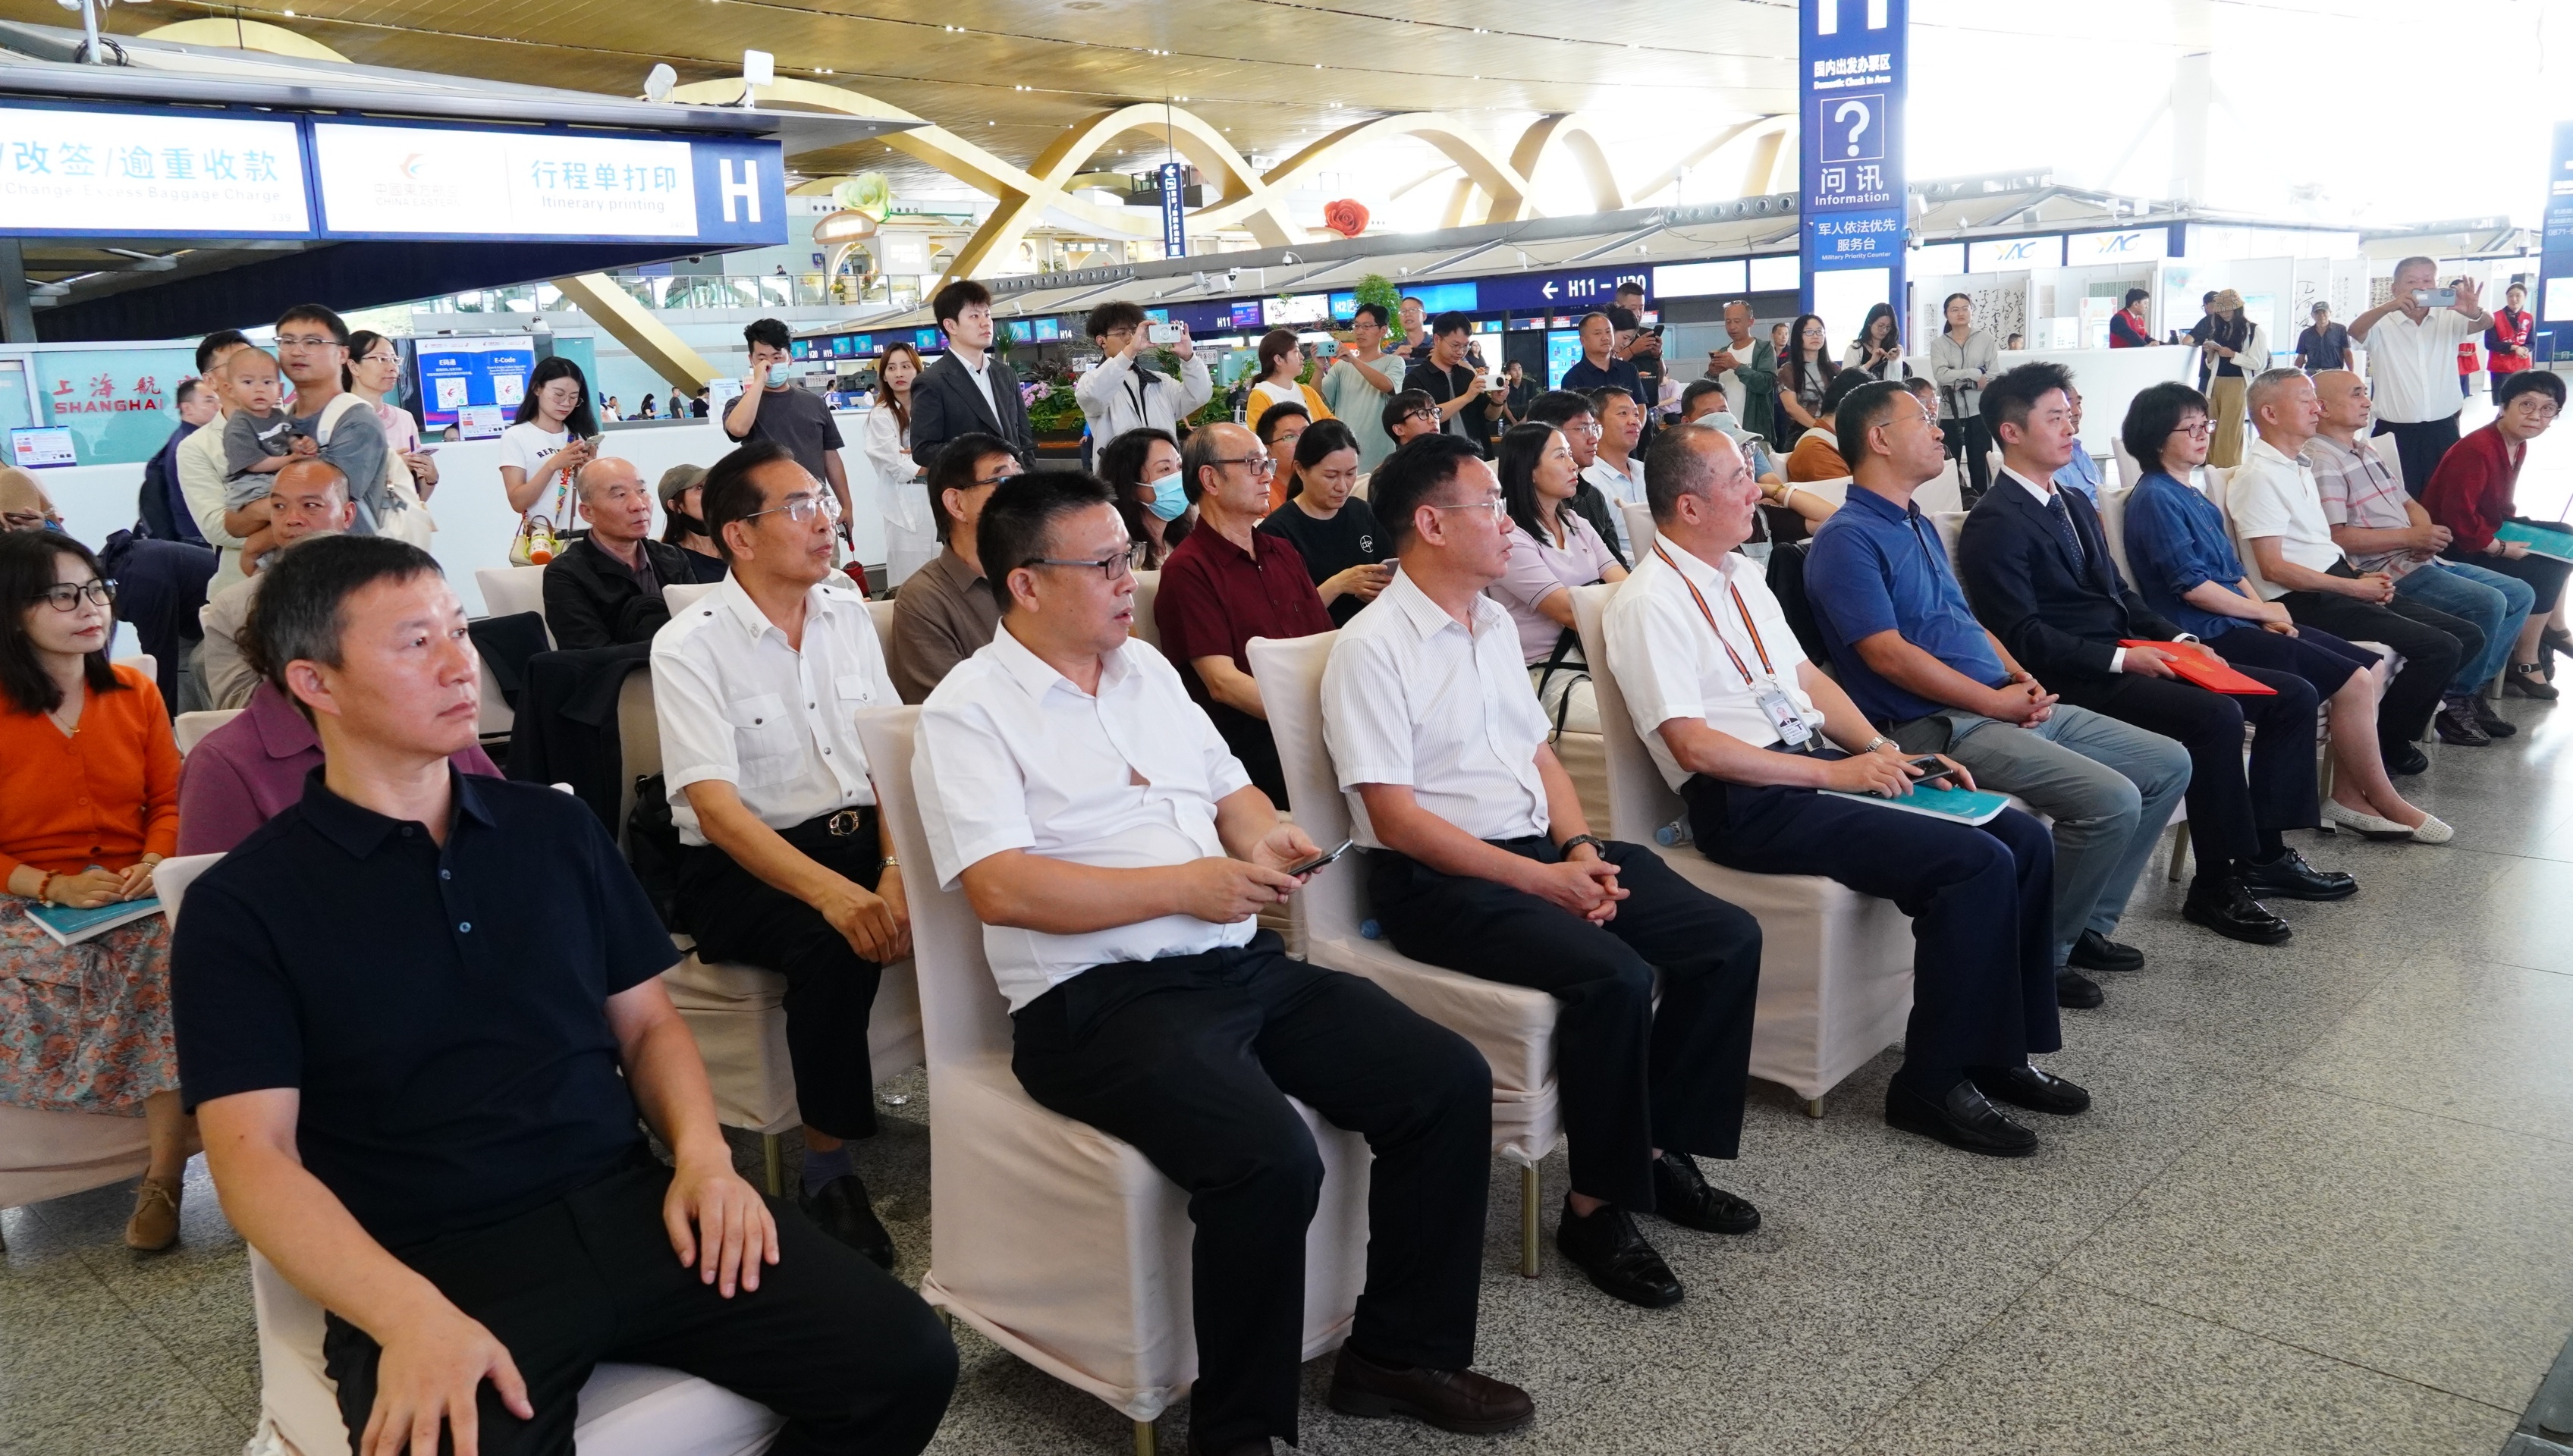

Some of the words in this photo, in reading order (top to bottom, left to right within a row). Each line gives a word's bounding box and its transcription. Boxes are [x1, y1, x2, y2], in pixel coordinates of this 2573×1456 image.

[531, 159, 677, 193] 行程单打印
[1821, 165, 1883, 194] 问讯
[5, 181, 74, 199] Change
[148, 187, 219, 201] Baggage
[224, 188, 281, 203] Charge
[719, 158, 762, 223] H
[375, 196, 410, 207] CHINA
[413, 197, 462, 208] EASTERN
[542, 195, 604, 212] Itinerary
[608, 197, 665, 213] printing
[1814, 192, 1890, 206] Information
[270, 213, 292, 222] 339
[1817, 218, 1896, 236] 军人依法优先
[1836, 237, 1877, 252] 服务台
[1568, 278, 1595, 297] H11
[1217, 316, 1230, 328] H11
[1059, 329, 1073, 340] H14
[809, 350, 818, 359] H20
[823, 349, 833, 358] H19
[873, 344, 884, 353] H18
[55, 398, 164, 415] SHANGHAI
